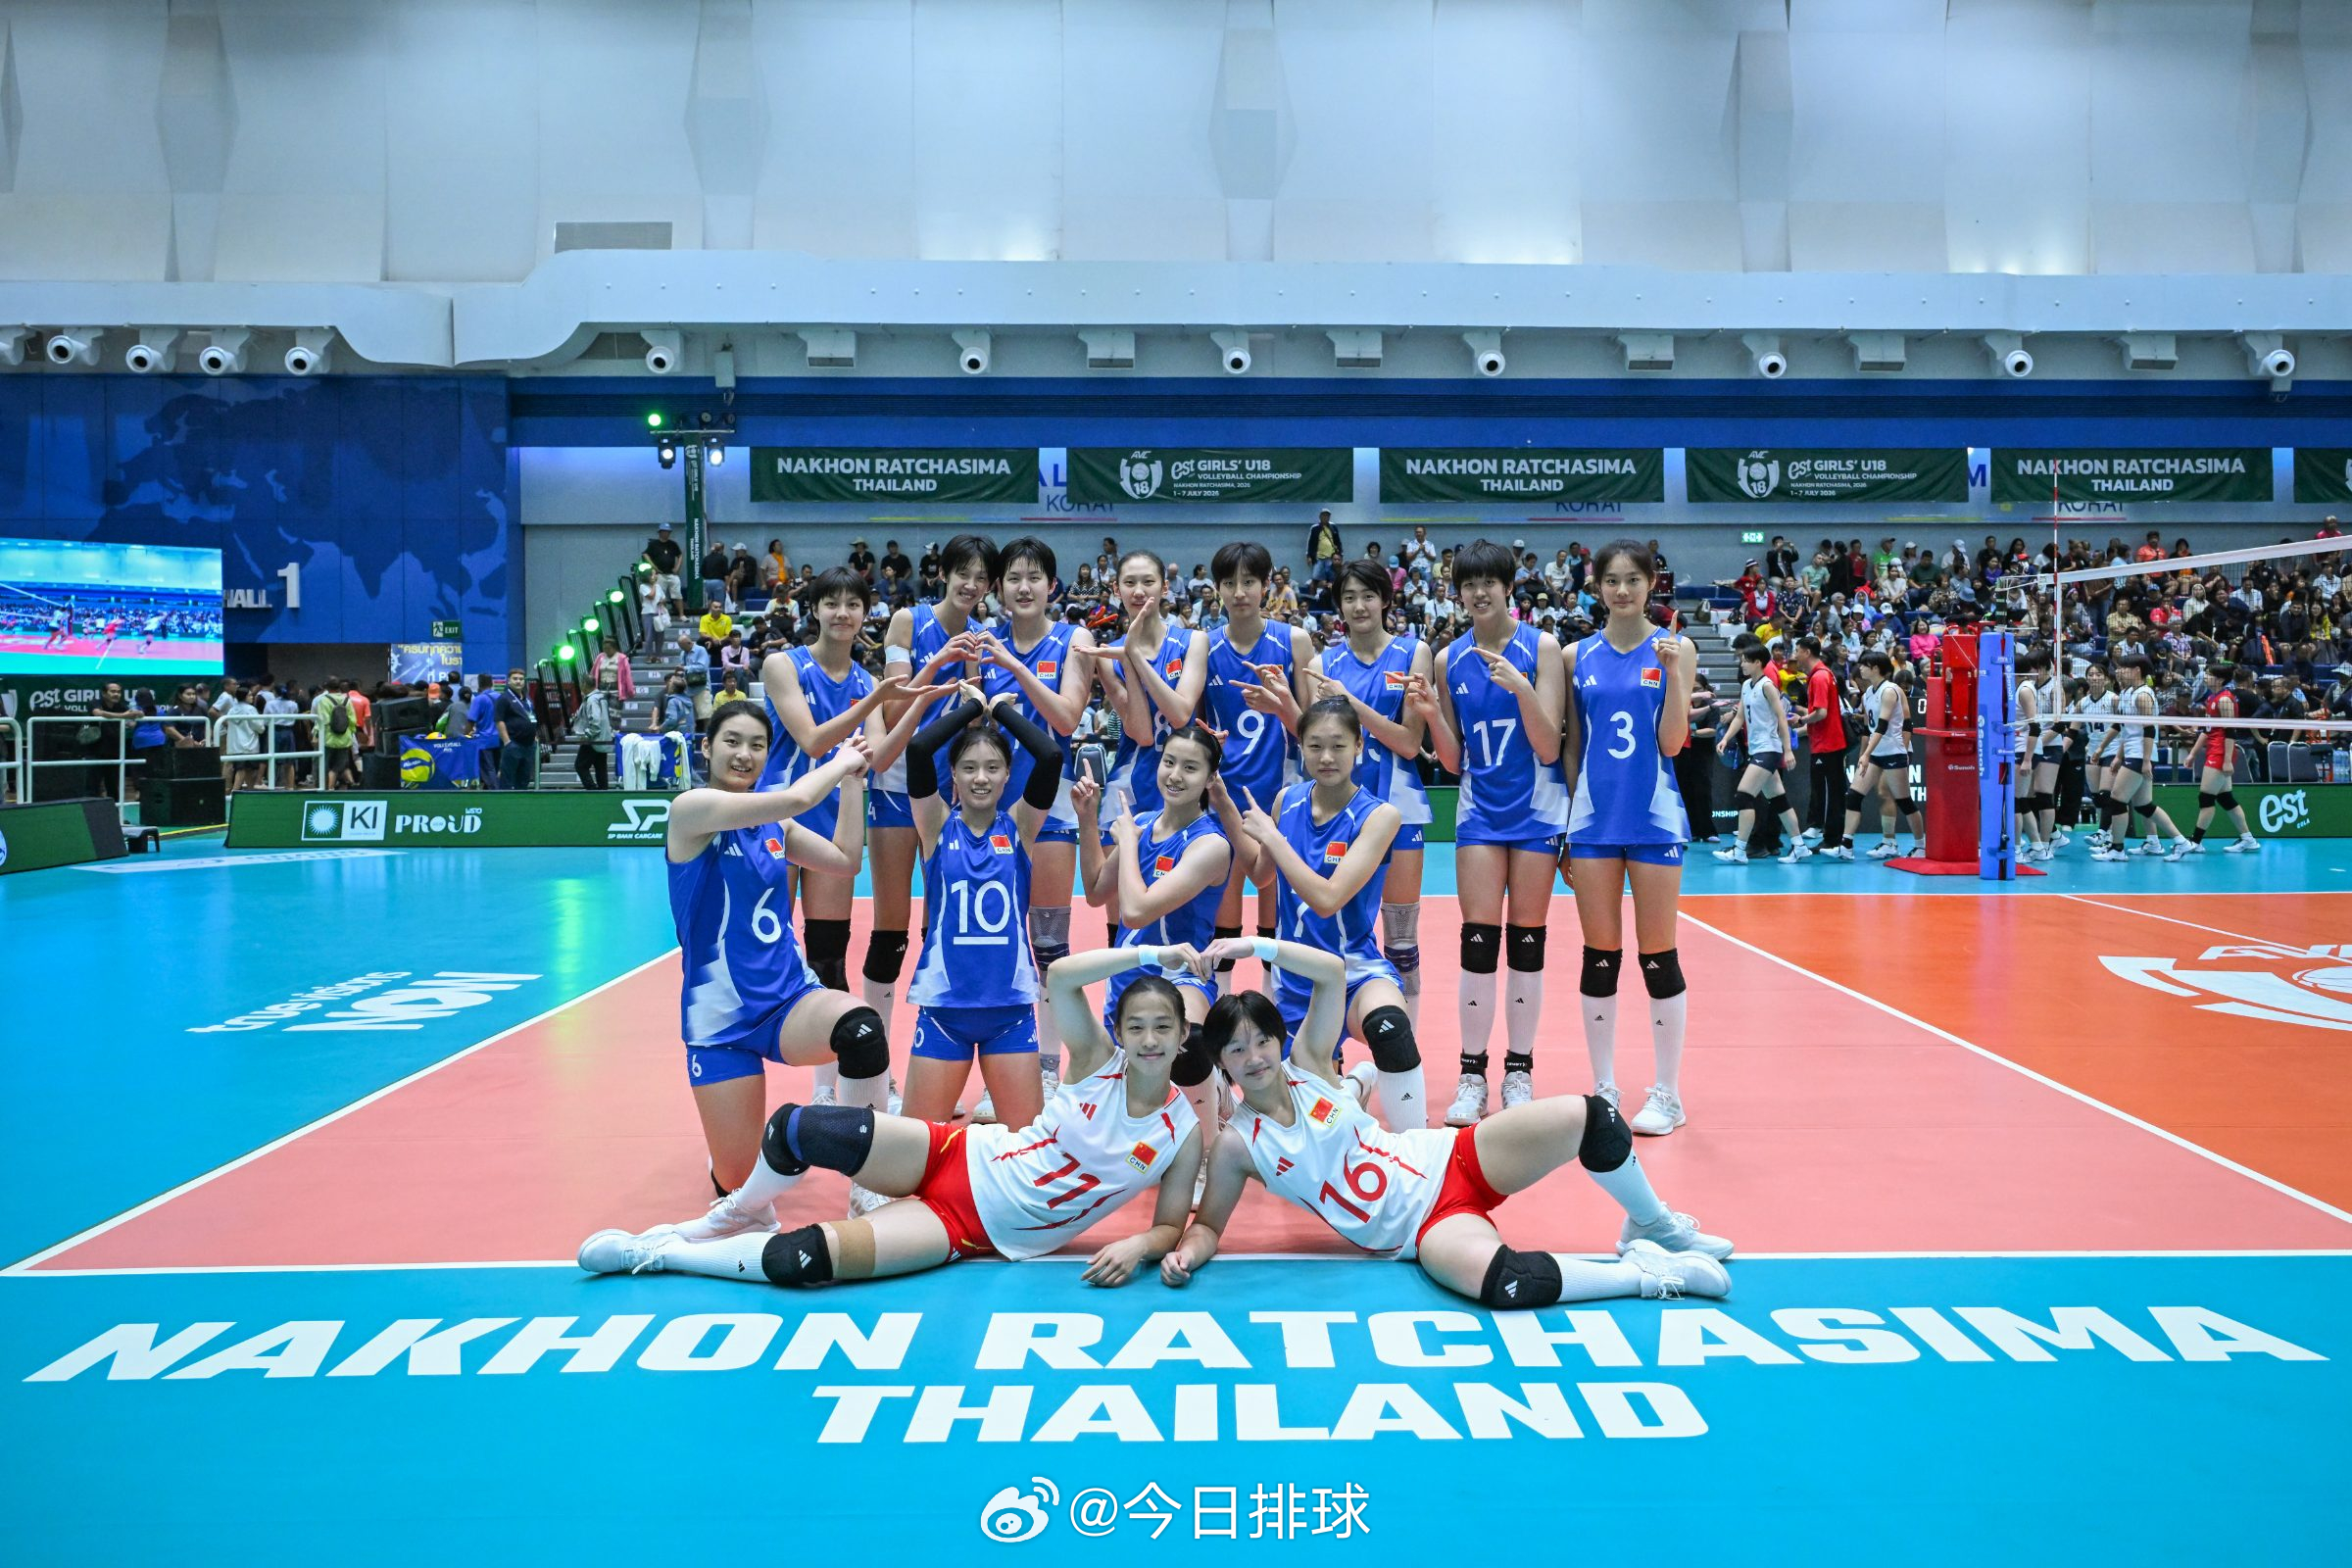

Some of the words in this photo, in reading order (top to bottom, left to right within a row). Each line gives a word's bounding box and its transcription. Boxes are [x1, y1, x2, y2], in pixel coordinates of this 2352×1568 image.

[777, 458, 870, 474] NAKHON
[875, 458, 1011, 474] RATCHASIMA
[1171, 460, 1196, 480] est
[1245, 460, 1271, 471] U18
[1405, 459, 1498, 474] NAKHON
[1502, 459, 1637, 474] RATCHASIMA
[1788, 460, 1812, 480] est
[1861, 460, 1886, 471] U18
[2018, 459, 2108, 475] NAKHON
[2113, 458, 2246, 474] RATCHASIMA
[853, 478, 937, 492] THAILAND
[1134, 480, 1150, 495] 18
[1480, 478, 1564, 492] THAILAND
[1751, 480, 1767, 495] 18
[2091, 478, 2174, 492] THAILAND
[277, 563, 300, 609] 1
[1868, 710, 1876, 728] 8
[1237, 710, 1265, 755] 9
[1473, 717, 1517, 767] 17
[1607, 710, 1637, 760] 3
[350, 806, 378, 830] KI
[2259, 789, 2309, 833] est
[752, 887, 782, 944] 6
[951, 879, 1011, 934] 10
[691, 1054, 703, 1078] 6
[1326, 1106, 1341, 1126] CHN
[1129, 1155, 1147, 1172] CHN
[1033, 1152, 1102, 1209] 11
[1319, 1148, 1389, 1226] 16
[22, 1312, 924, 1383] NAKHON
[974, 1305, 2331, 1370] RATCHASIMA
[811, 1382, 1709, 1445] THAILAND
